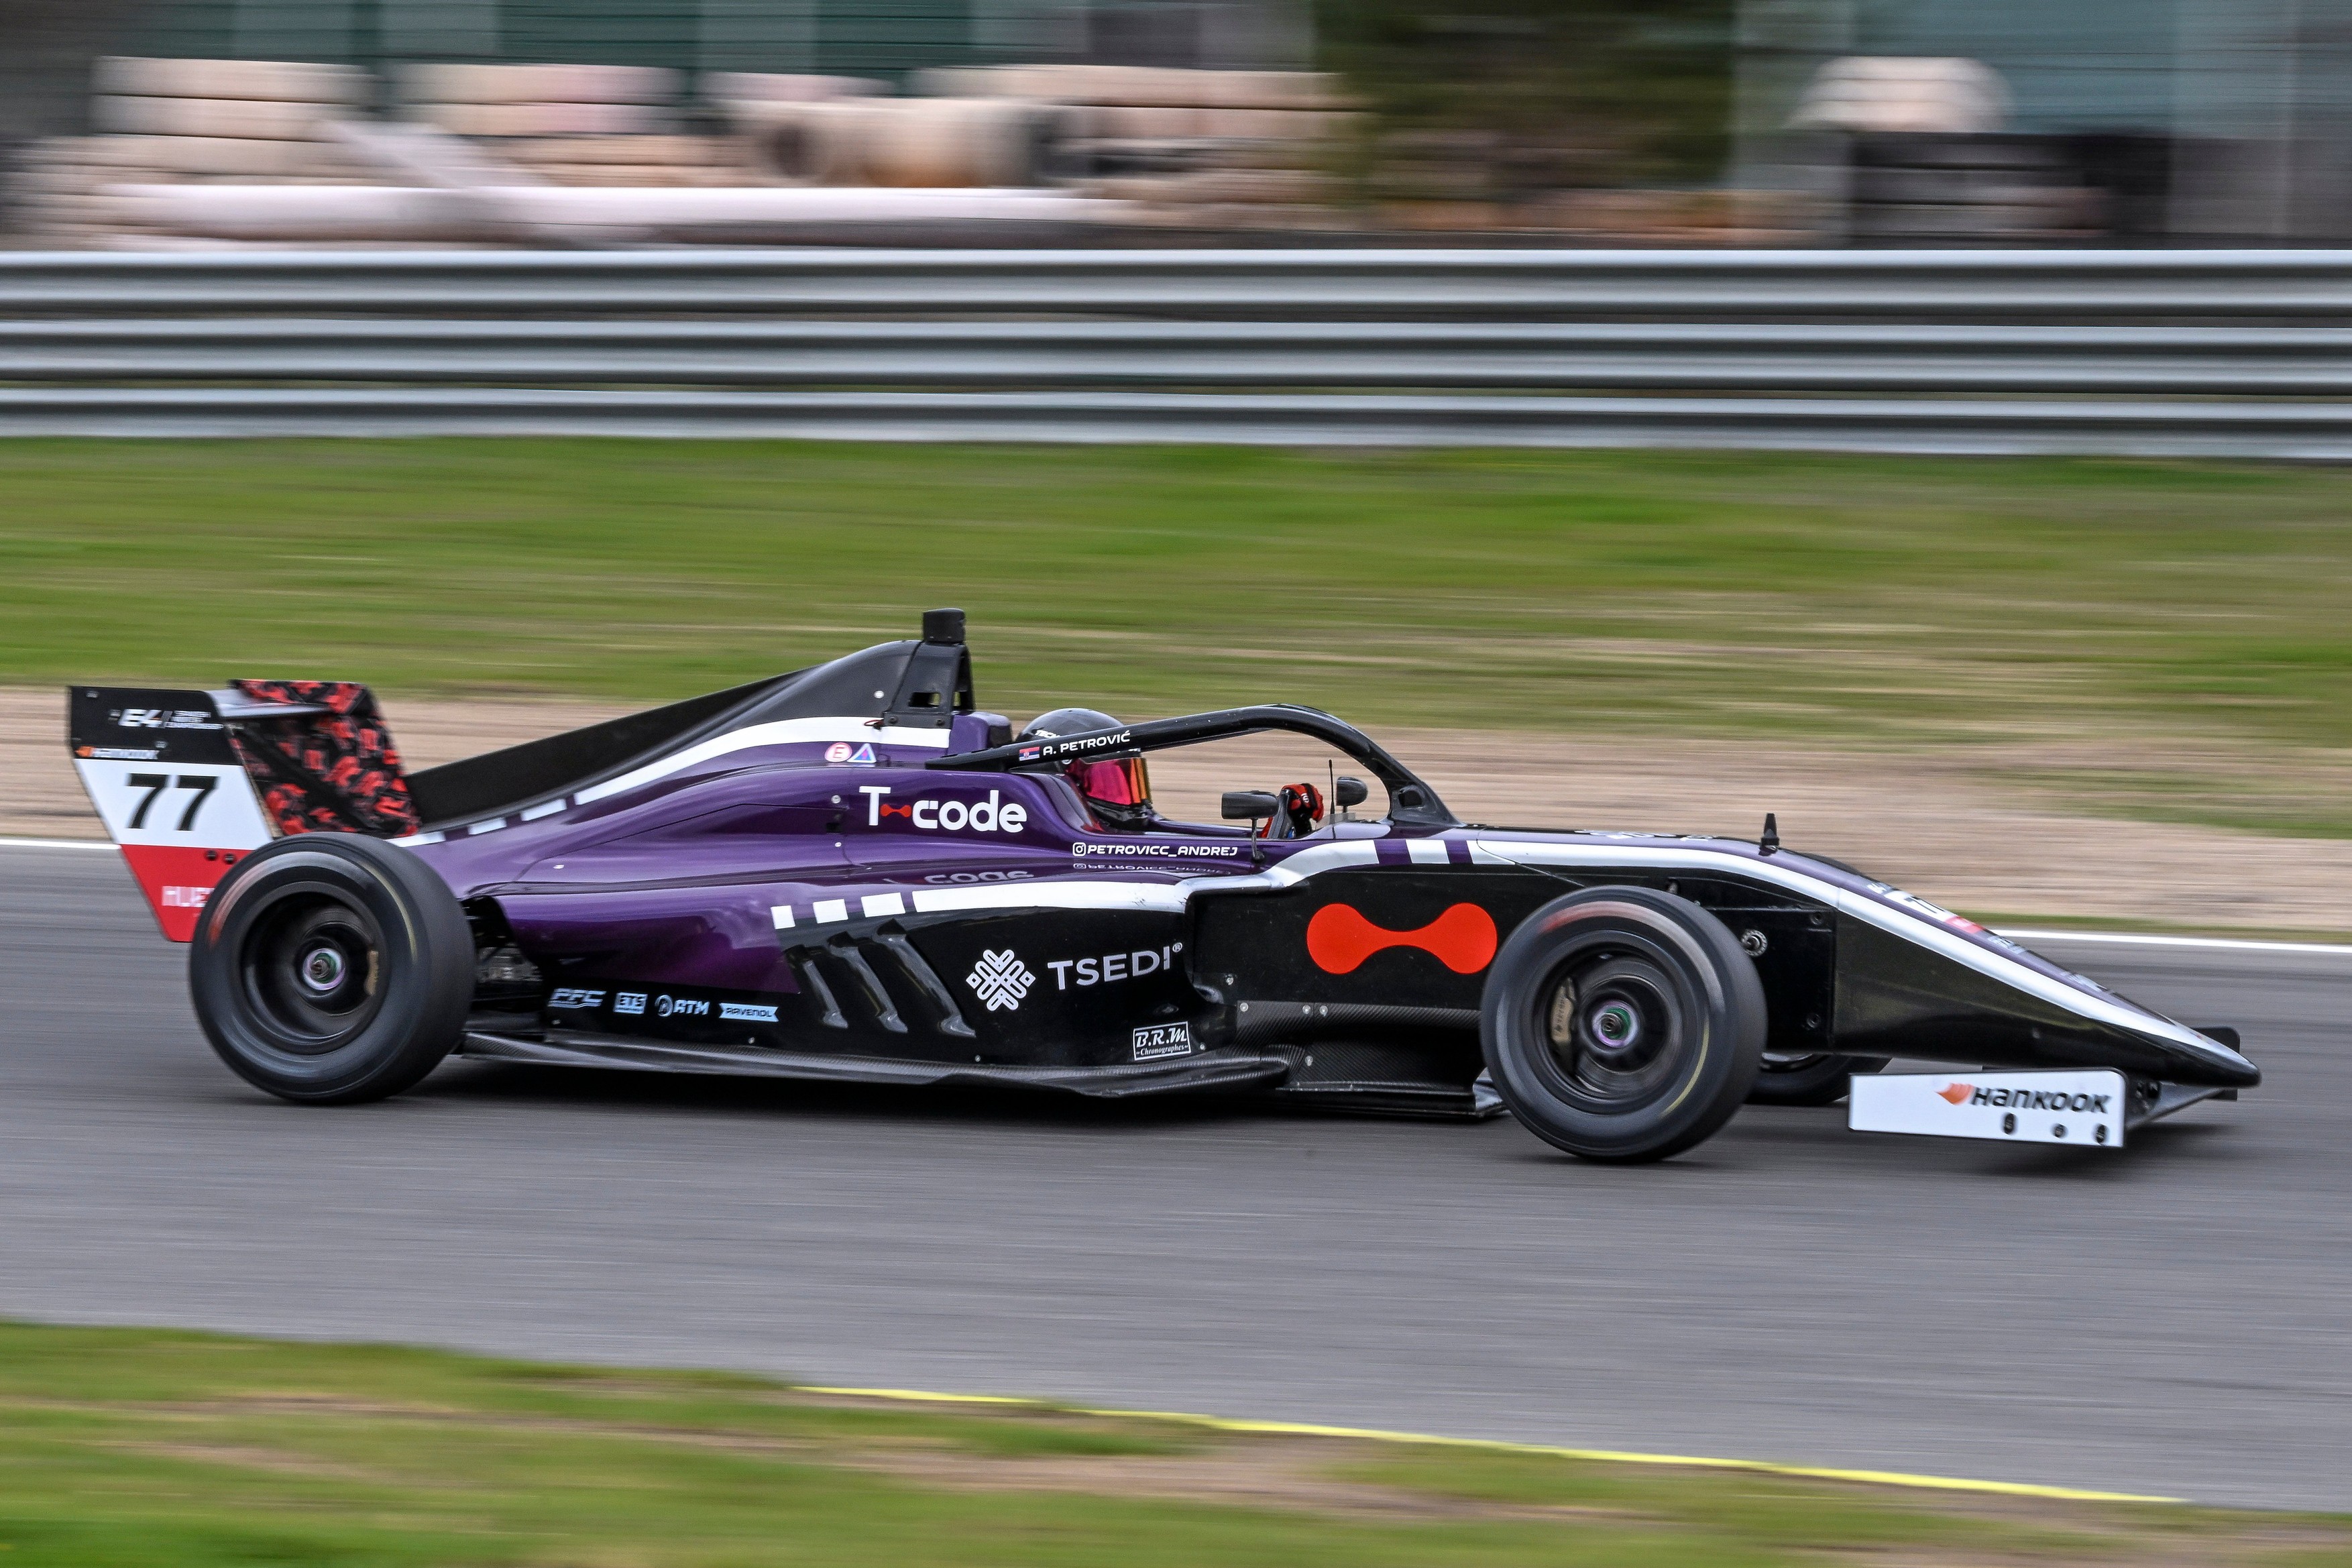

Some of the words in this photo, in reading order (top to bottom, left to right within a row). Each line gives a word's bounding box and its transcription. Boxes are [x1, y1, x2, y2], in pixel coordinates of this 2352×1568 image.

[1043, 746, 1057, 756] A.
[1060, 730, 1131, 753] PETROVIĆ
[125, 773, 221, 832] 77
[1087, 845, 1238, 857] PETROVICC_ANDREJ
